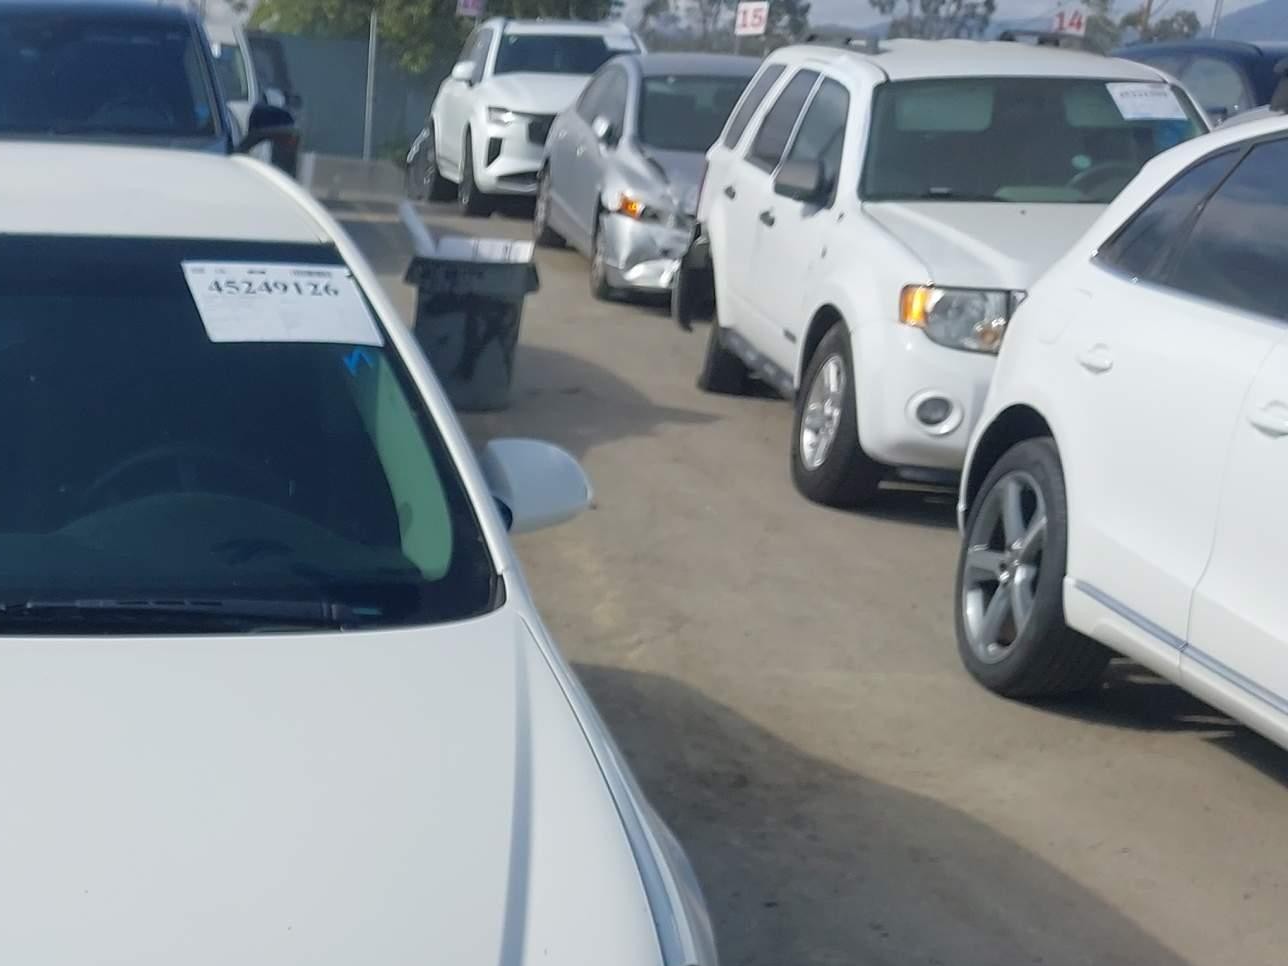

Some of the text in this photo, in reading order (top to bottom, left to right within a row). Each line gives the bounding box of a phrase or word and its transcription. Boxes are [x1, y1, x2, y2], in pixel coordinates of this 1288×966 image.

[741, 8, 766, 28] 15
[1055, 10, 1083, 32] 14
[208, 280, 340, 297] 45249126
